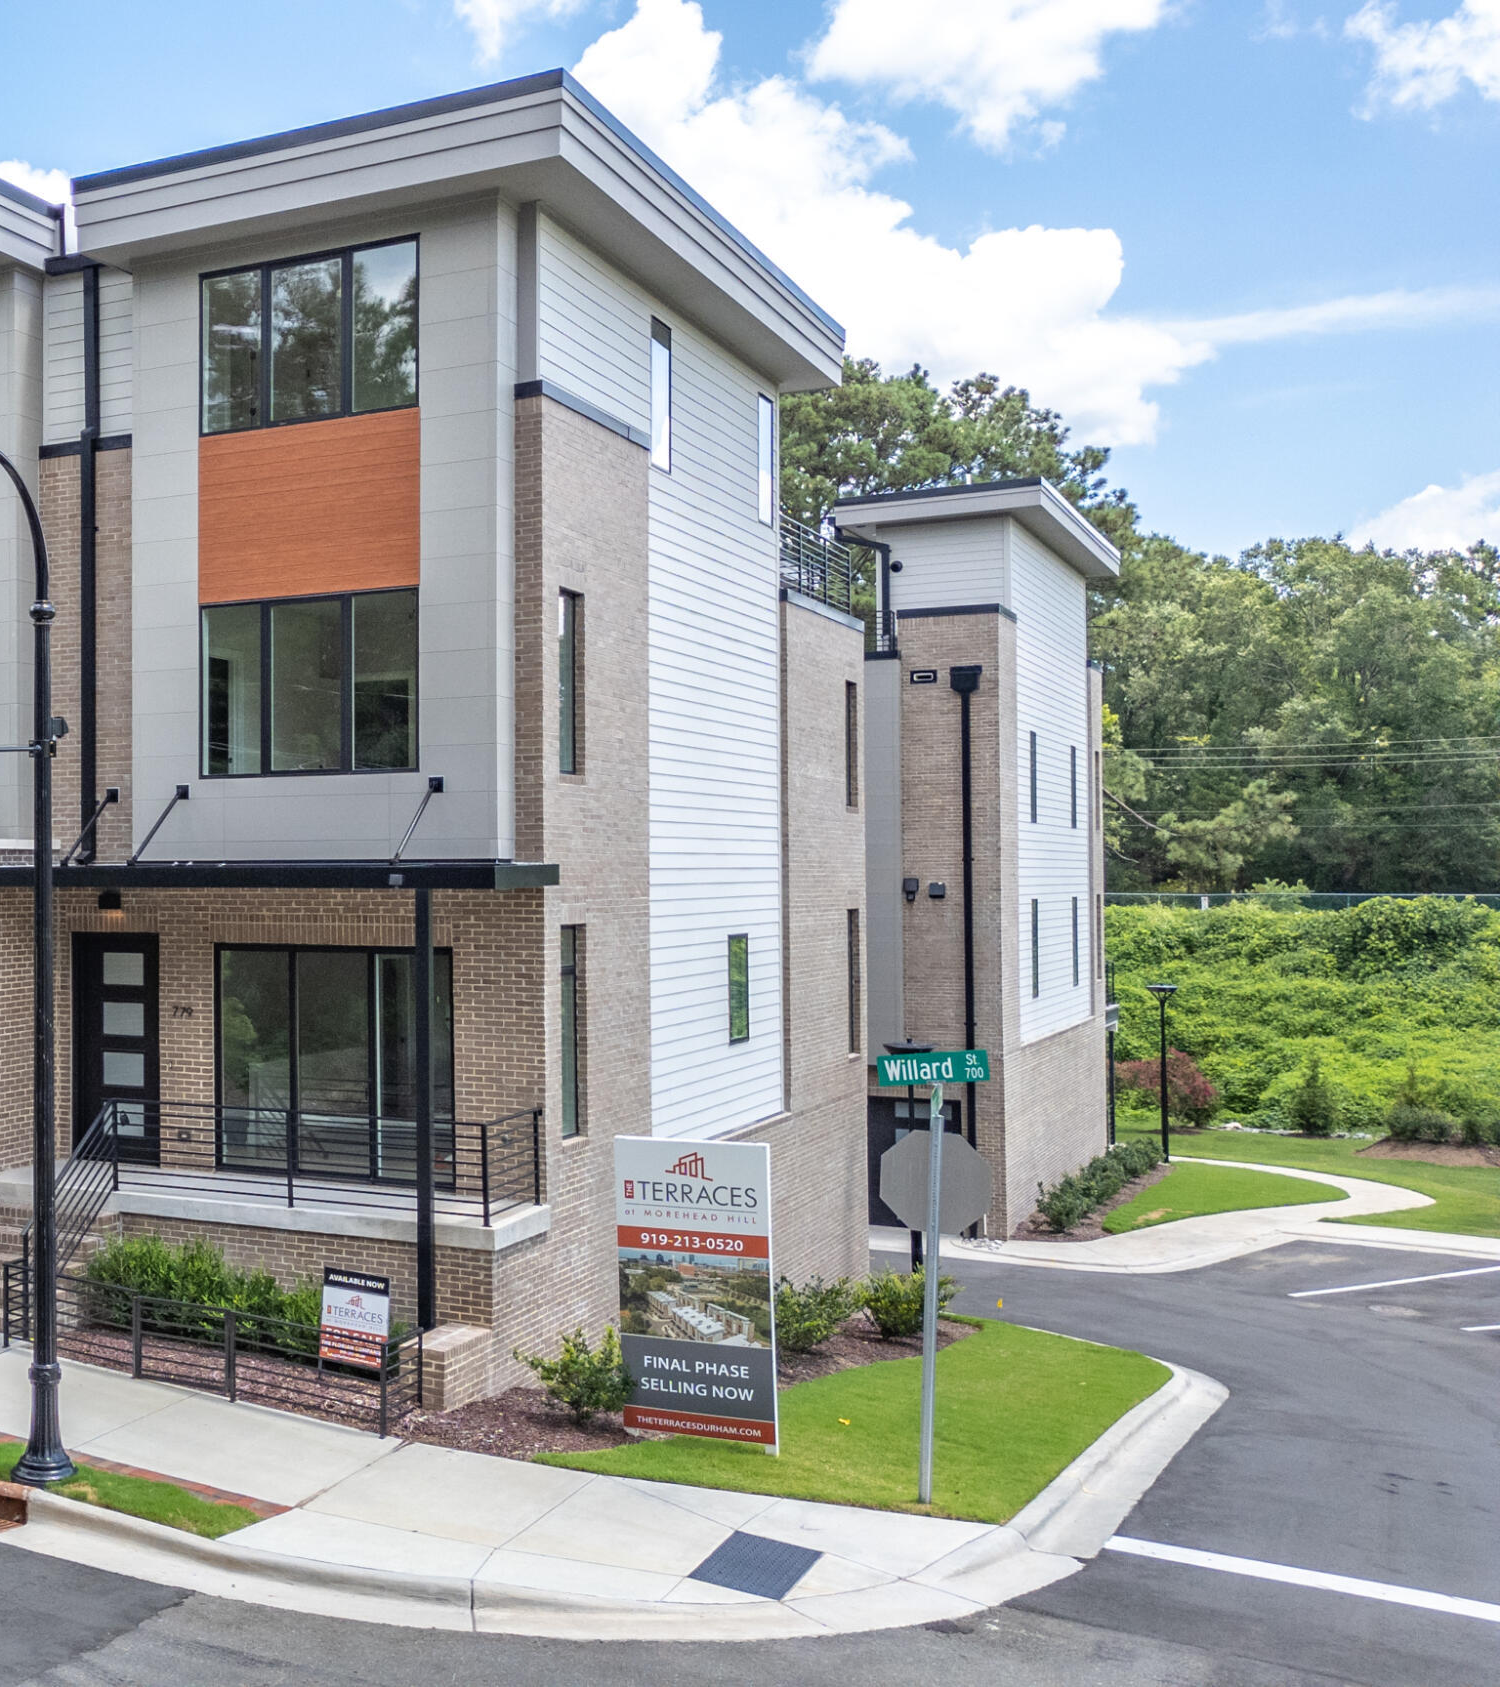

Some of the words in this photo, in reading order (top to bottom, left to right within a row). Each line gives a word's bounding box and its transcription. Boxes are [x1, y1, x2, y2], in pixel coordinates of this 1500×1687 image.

[172, 1005, 194, 1017] 779
[884, 1057, 954, 1081] Willard
[964, 1067, 984, 1079] 700
[637, 1181, 758, 1208] TERRACES
[644, 1209, 718, 1221] MOREHEAD
[727, 1215, 757, 1224] HILL
[640, 1232, 744, 1251] 919-213-0520
[329, 1273, 366, 1286] AVAILABLE
[366, 1280, 385, 1289] NOW
[333, 1306, 383, 1324] TERRACES
[643, 1355, 691, 1373] FINAL
[695, 1361, 750, 1379] PHASE
[640, 1377, 707, 1396] SELLING
[712, 1385, 754, 1402] NOW
[636, 1415, 762, 1437] THETERRACESDURHAM.COM
